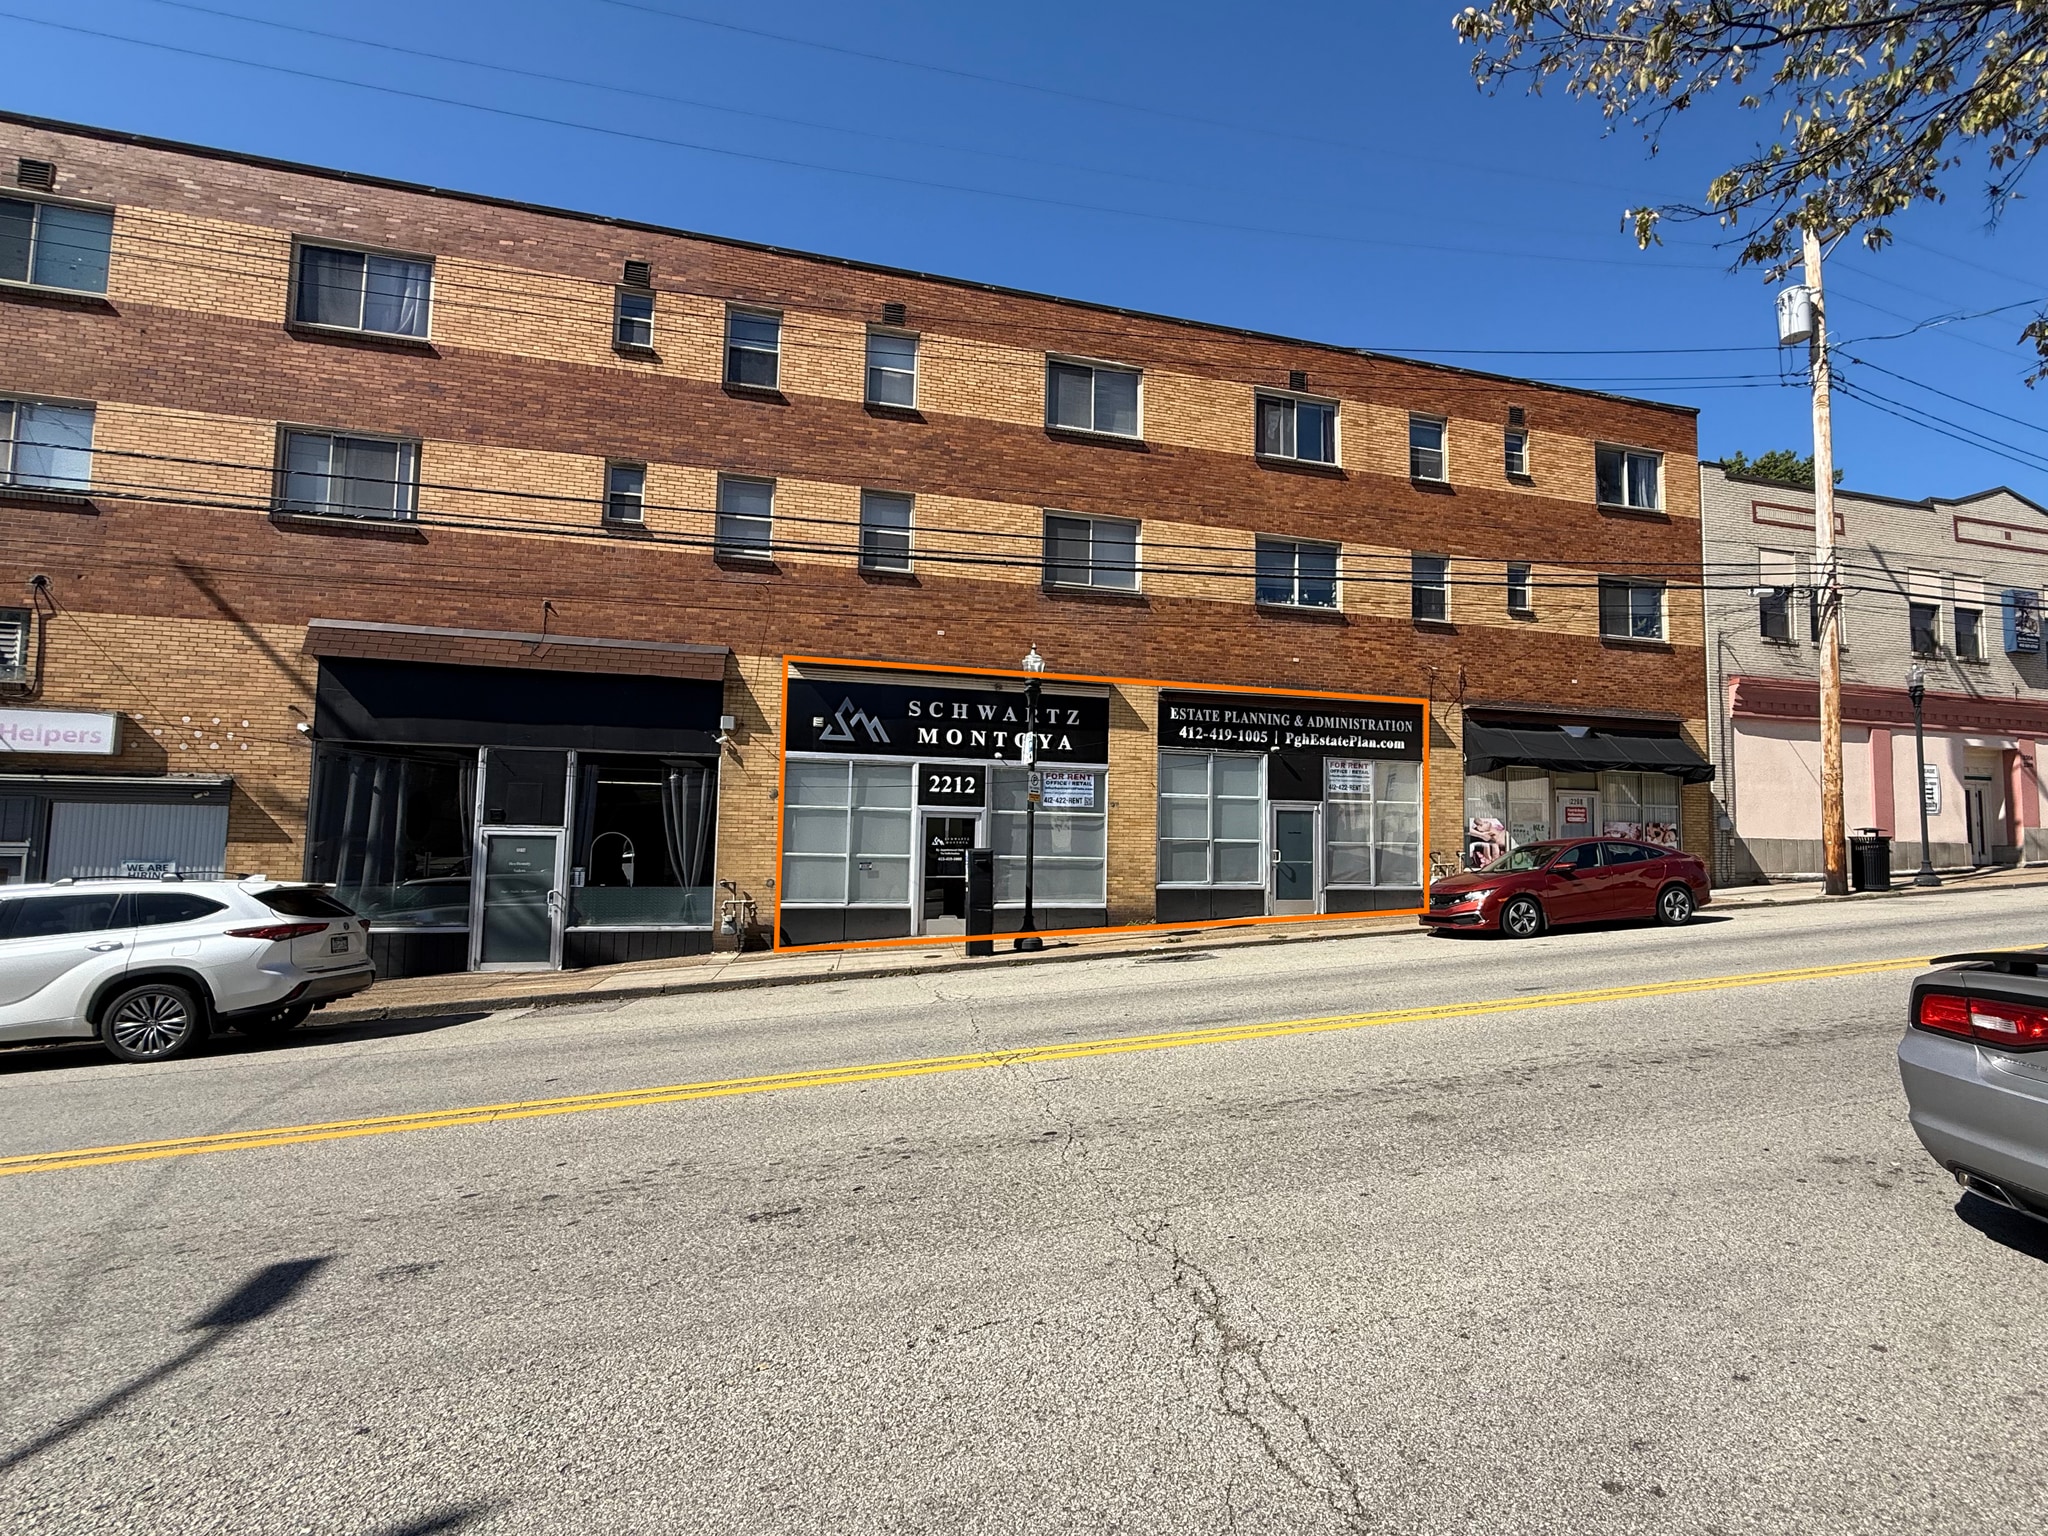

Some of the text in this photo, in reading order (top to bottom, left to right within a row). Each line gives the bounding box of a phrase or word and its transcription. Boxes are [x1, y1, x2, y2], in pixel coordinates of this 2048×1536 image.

[908, 700, 1080, 725] SCHWARTZ
[1170, 707, 1413, 733] ESTATE PLANNING & ADMINISTRATION
[0, 723, 102, 746] Helpers
[1179, 726, 1268, 743] 412-419-1005
[1285, 732, 1405, 750] PghEstatePlan.com
[929, 775, 976, 794] 2212
[127, 863, 169, 872] WE ARE
